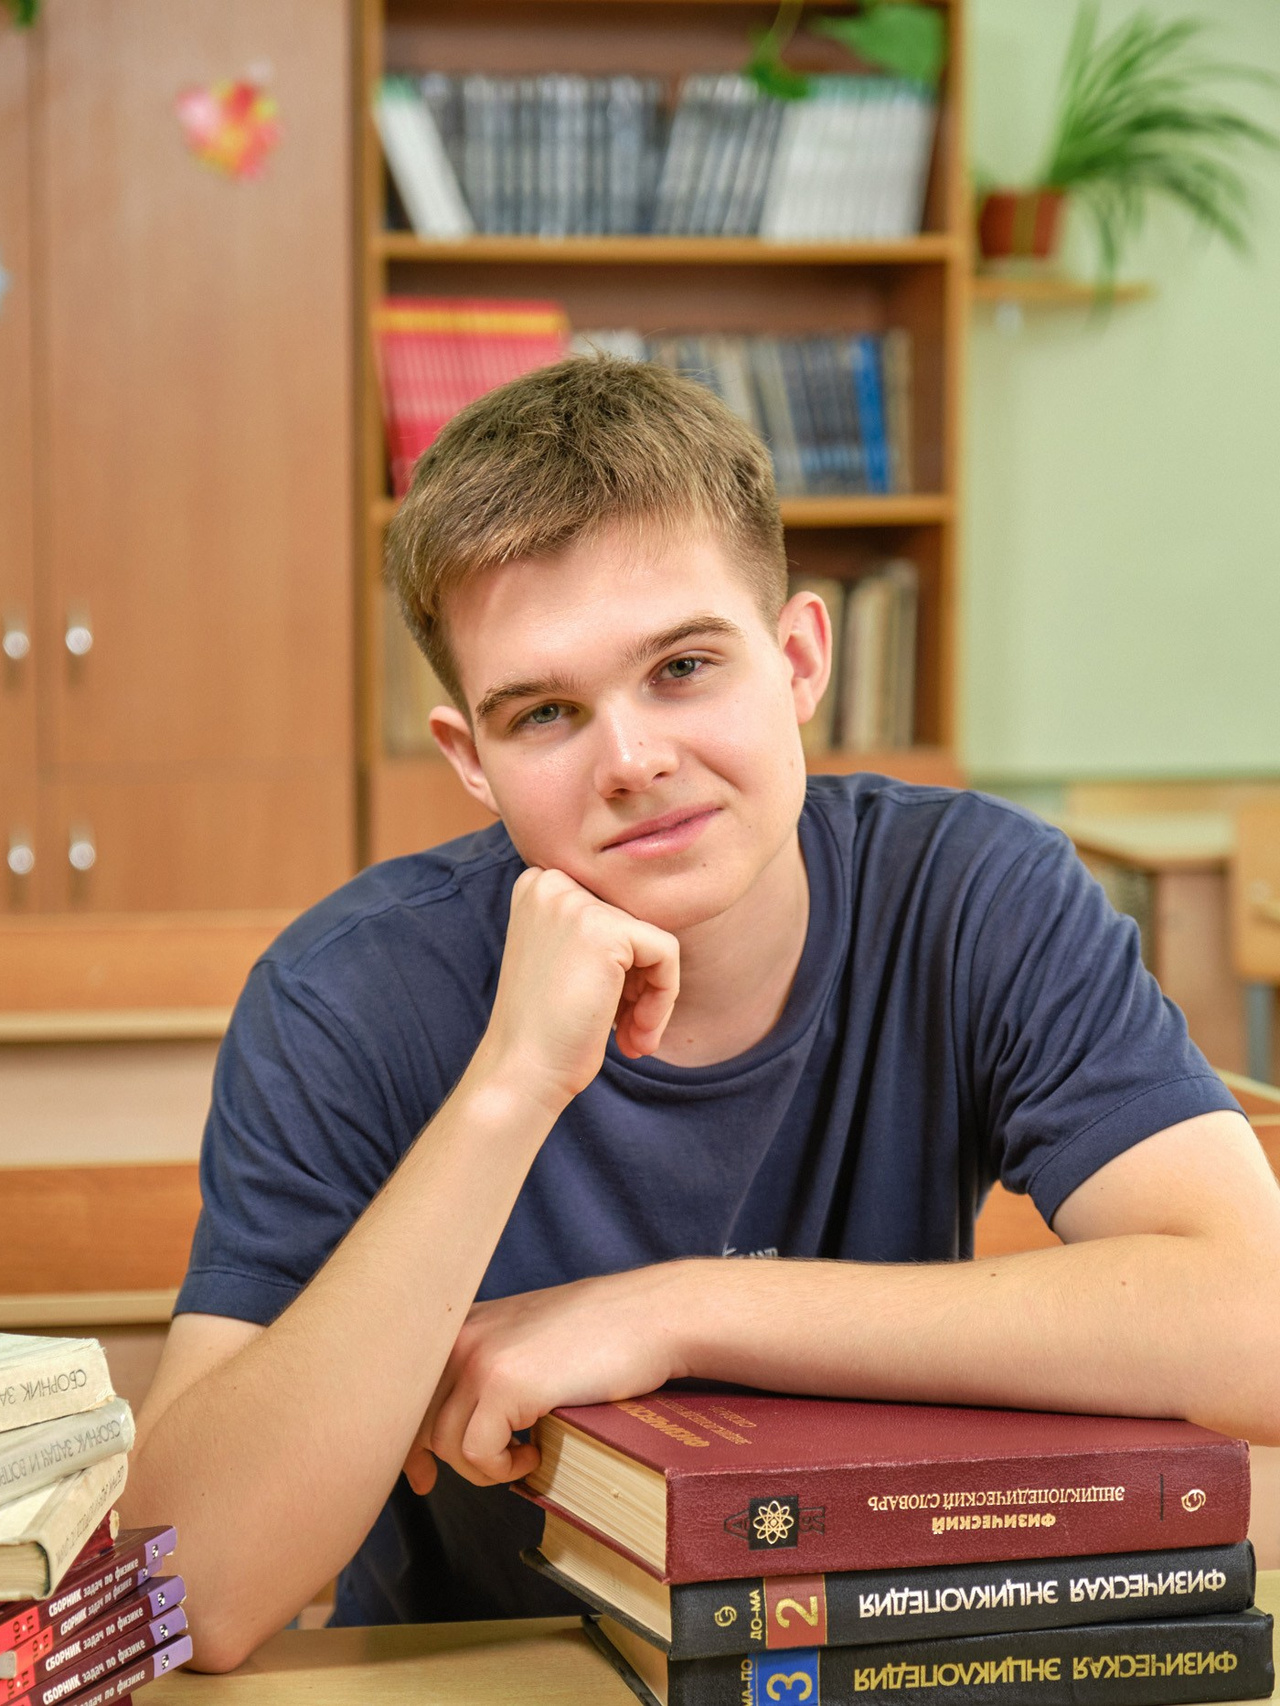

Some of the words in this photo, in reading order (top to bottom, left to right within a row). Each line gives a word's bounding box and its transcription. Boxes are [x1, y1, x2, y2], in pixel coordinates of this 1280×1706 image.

[20, 1368, 87, 1402] СБОРНИК
[40, 1439, 74, 1468] ЗАДАЧ
[74, 1420, 121, 1454] СБОРНИК
[29, 1453, 41, 1474] И
[867, 1493, 941, 1512] СЛОВАРЬ
[942, 1486, 1126, 1510] ЭНЦИКЛОПЕДИЧЕСКИЙ
[931, 1513, 1057, 1535] ФИЗИЧЕСКИЙ
[48, 1589, 82, 1618] СБОРНИК
[83, 1578, 103, 1598] задач
[104, 1573, 114, 1586] по
[115, 1558, 139, 1581] физике
[858, 1579, 1059, 1618] ЭНЦИКЛОПЕДИЯ
[1069, 1568, 1227, 1603] ФИЗИЧЕСКАЯ
[60, 1607, 87, 1636] СБОРНИК
[87, 1598, 104, 1616] задач
[104, 1592, 112, 1604] по
[113, 1577, 133, 1600] физике
[775, 1595, 818, 1628] 2
[45, 1641, 82, 1672] СБОРНИК
[83, 1630, 104, 1650] задач
[106, 1624, 116, 1637] по
[117, 1607, 144, 1632] физике
[42, 1674, 82, 1705] СБОРНИК
[82, 1663, 105, 1683] задач
[106, 1656, 117, 1670] по
[118, 1639, 146, 1664] физике
[853, 1655, 1062, 1692] ЭНЦИКЛОПЕДИЯ
[1072, 1651, 1238, 1681] ФИЗИЧЕСКАЯ
[105, 1687, 115, 1700] по
[116, 1670, 146, 1695] физике
[766, 1671, 813, 1702] 3
